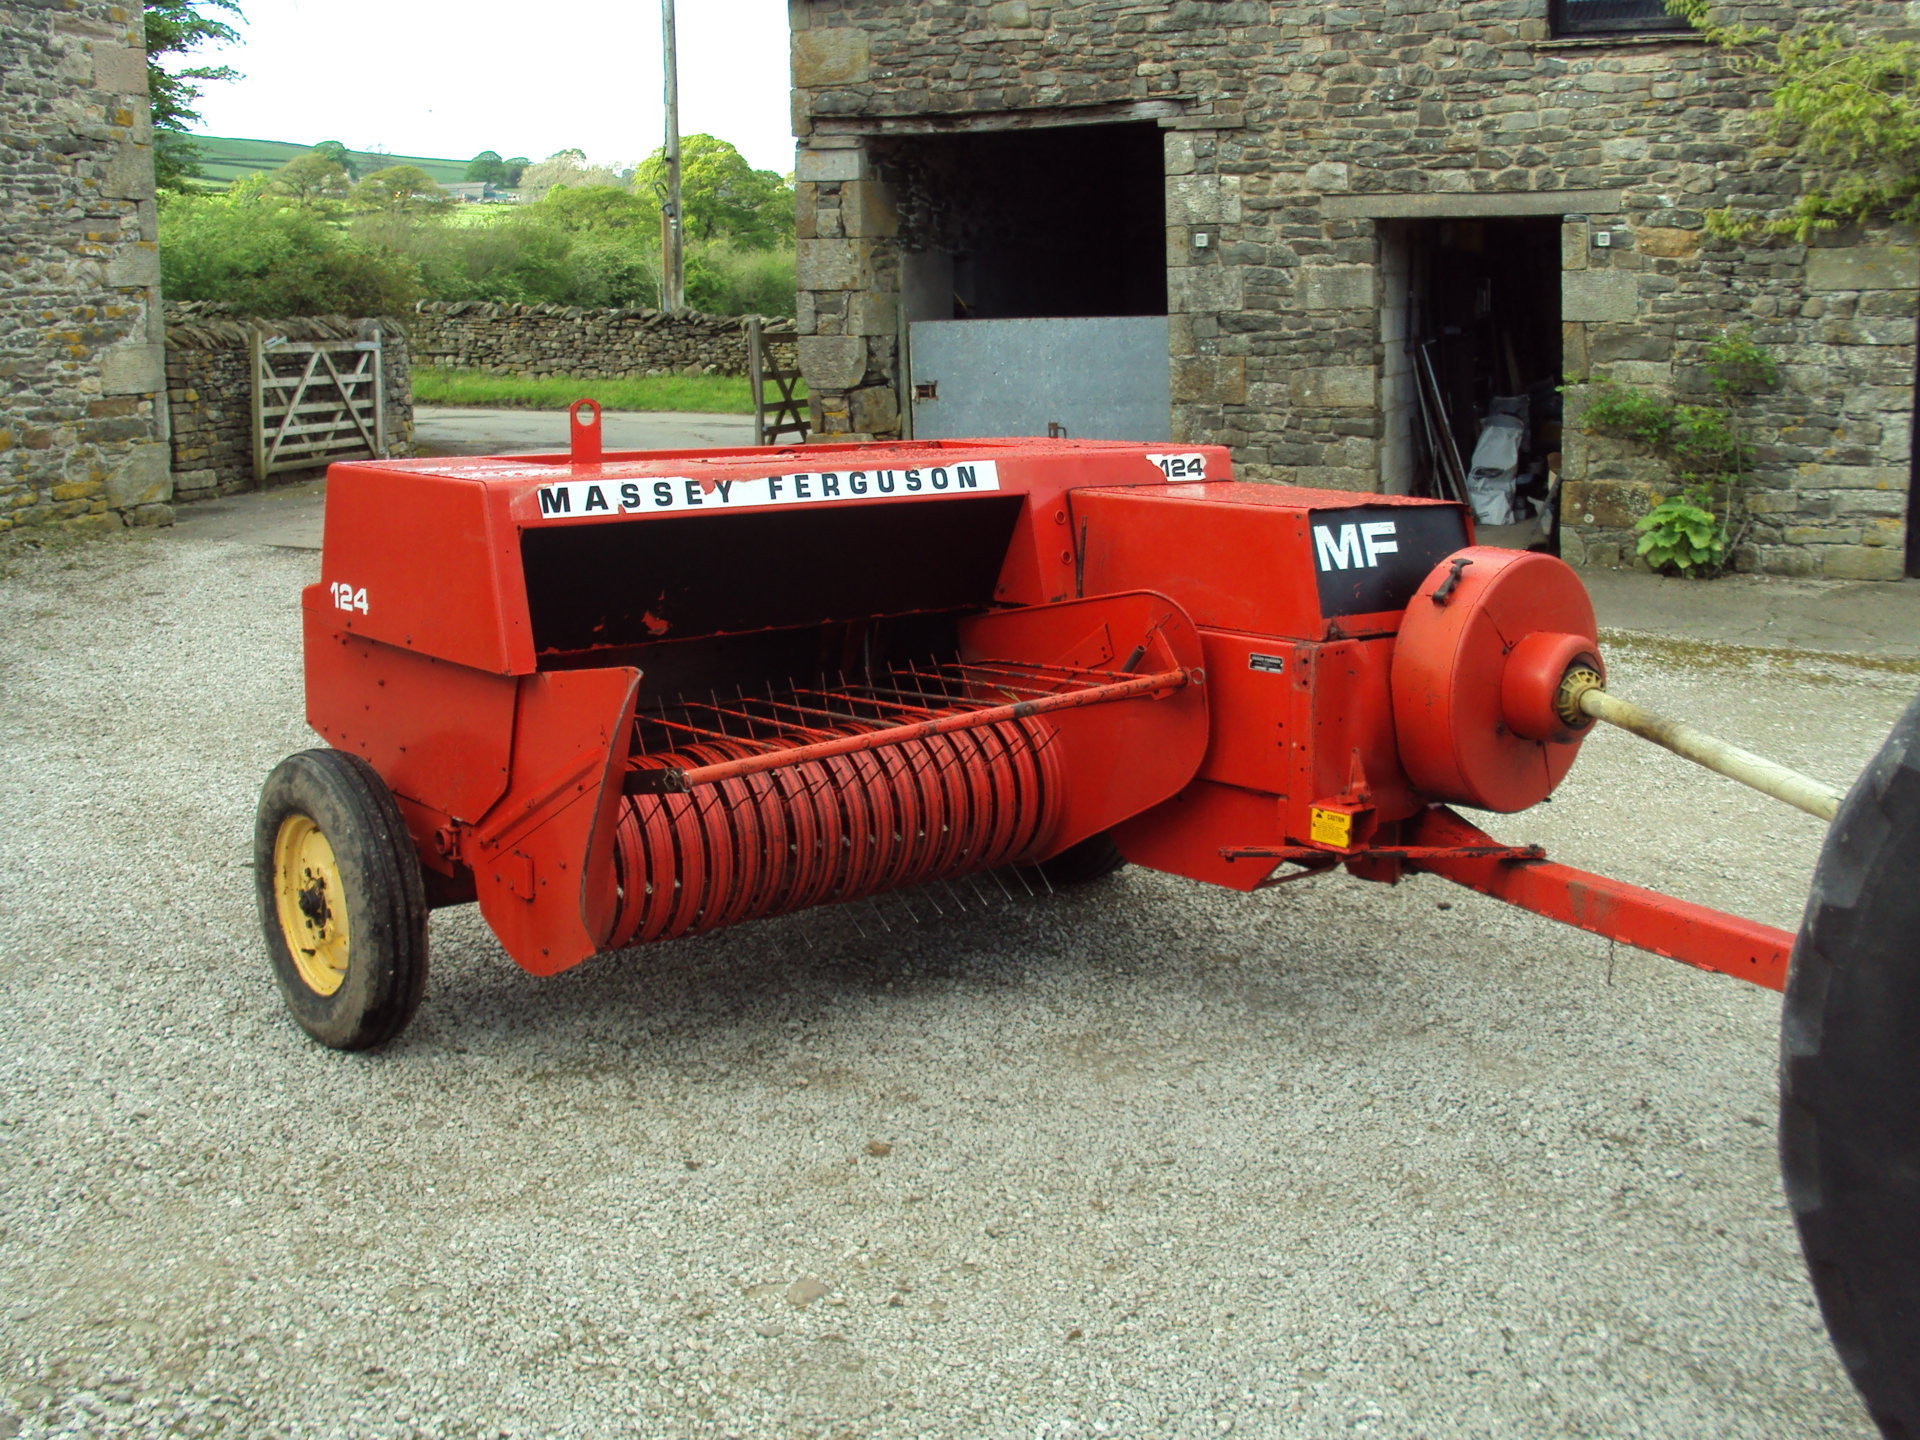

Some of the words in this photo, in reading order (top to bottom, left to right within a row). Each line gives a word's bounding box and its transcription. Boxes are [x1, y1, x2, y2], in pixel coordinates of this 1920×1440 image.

[1160, 458, 1202, 477] 124
[540, 479, 732, 514] MASSEY
[768, 465, 978, 500] FERGUSON
[1313, 521, 1399, 572] MF
[330, 581, 369, 616] 124
